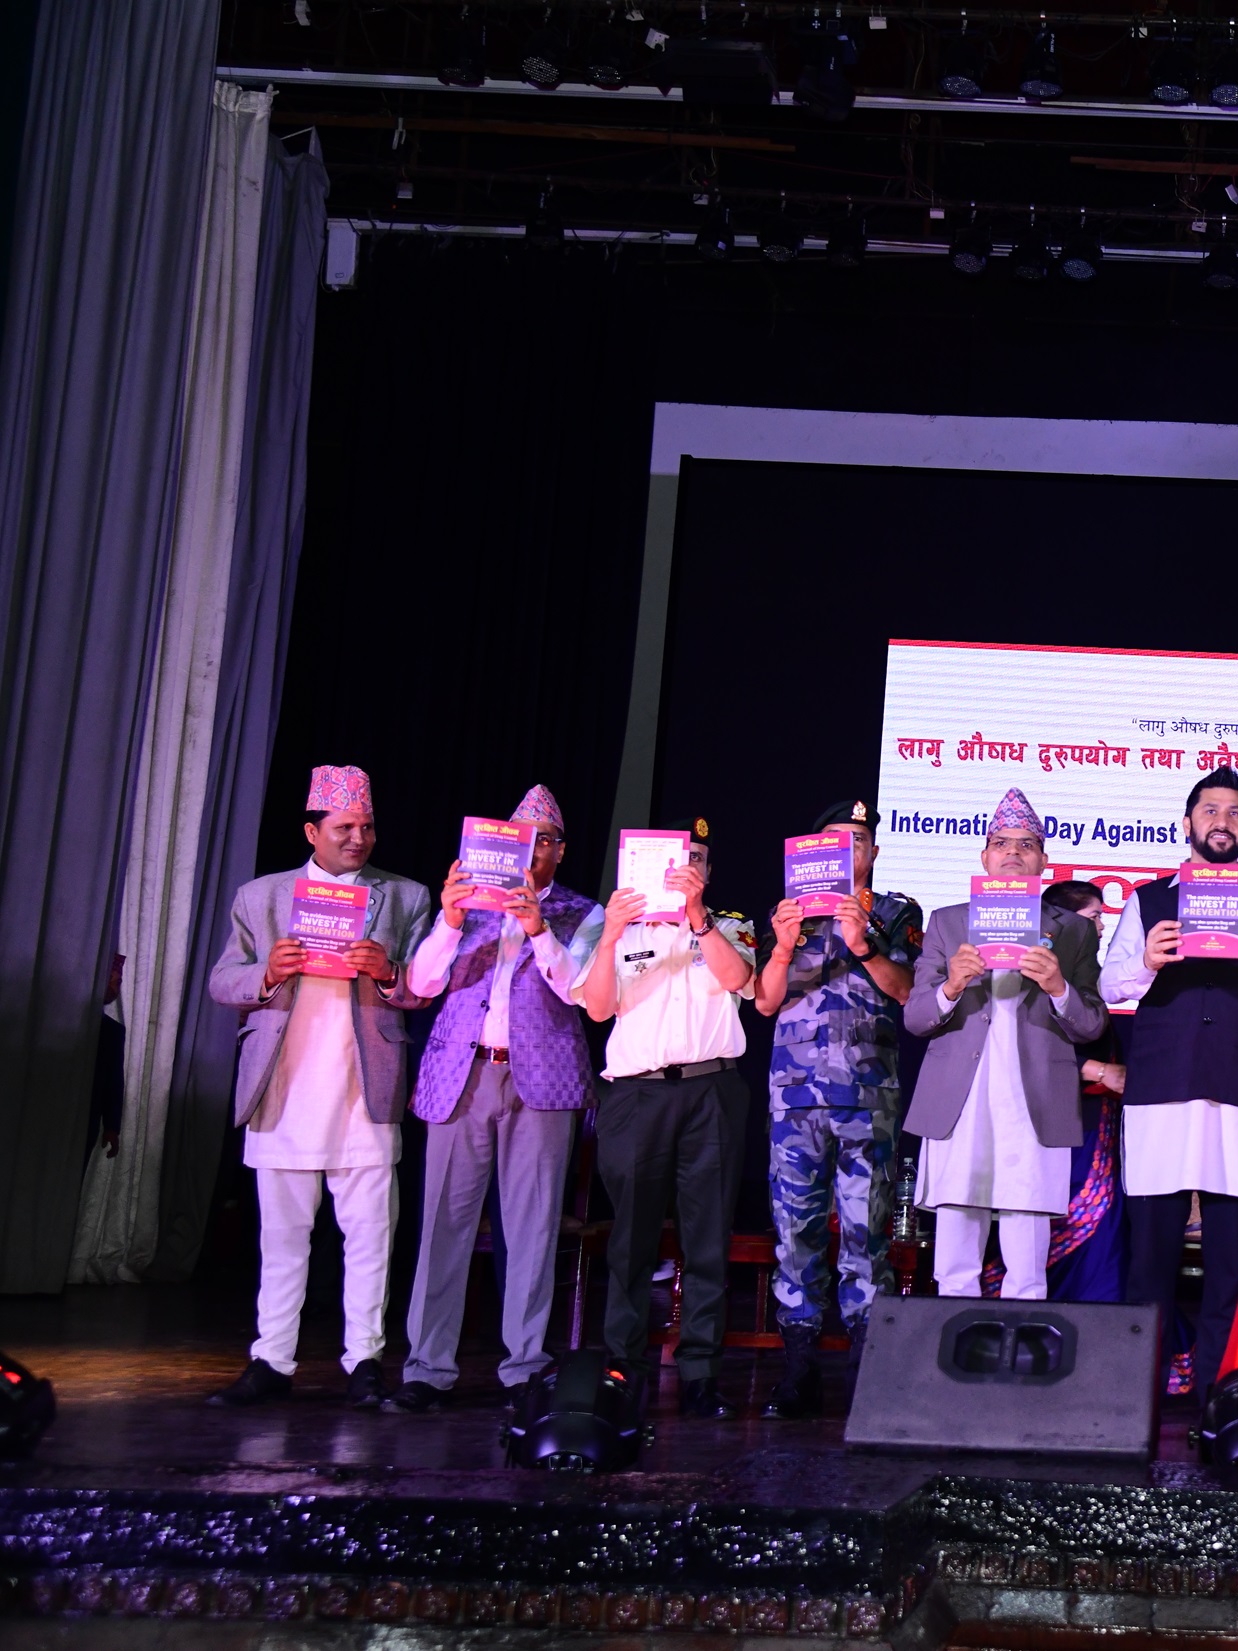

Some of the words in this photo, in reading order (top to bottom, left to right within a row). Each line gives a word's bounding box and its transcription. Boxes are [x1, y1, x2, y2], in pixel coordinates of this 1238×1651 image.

[1171, 717, 1210, 734] औषध
[897, 737, 944, 767] लागु
[1038, 740, 1130, 772] दुरुपयोग
[1140, 747, 1185, 770] तथा
[1044, 815, 1085, 846] Day
[1091, 818, 1177, 848] Against
[468, 853, 502, 864] INVEST
[503, 857, 514, 865] IN
[460, 860, 519, 874] PREVENTION
[795, 865, 827, 875] INVEST
[789, 870, 844, 882] PREVENTION
[1190, 900, 1224, 908] INVEST
[1227, 901, 1237, 909] IN
[980, 912, 1014, 920] INVEST
[301, 917, 337, 928] INVEST
[339, 922, 350, 930] IN
[973, 920, 1032, 928] PREVENTION
[293, 924, 355, 938] PREVENTION
